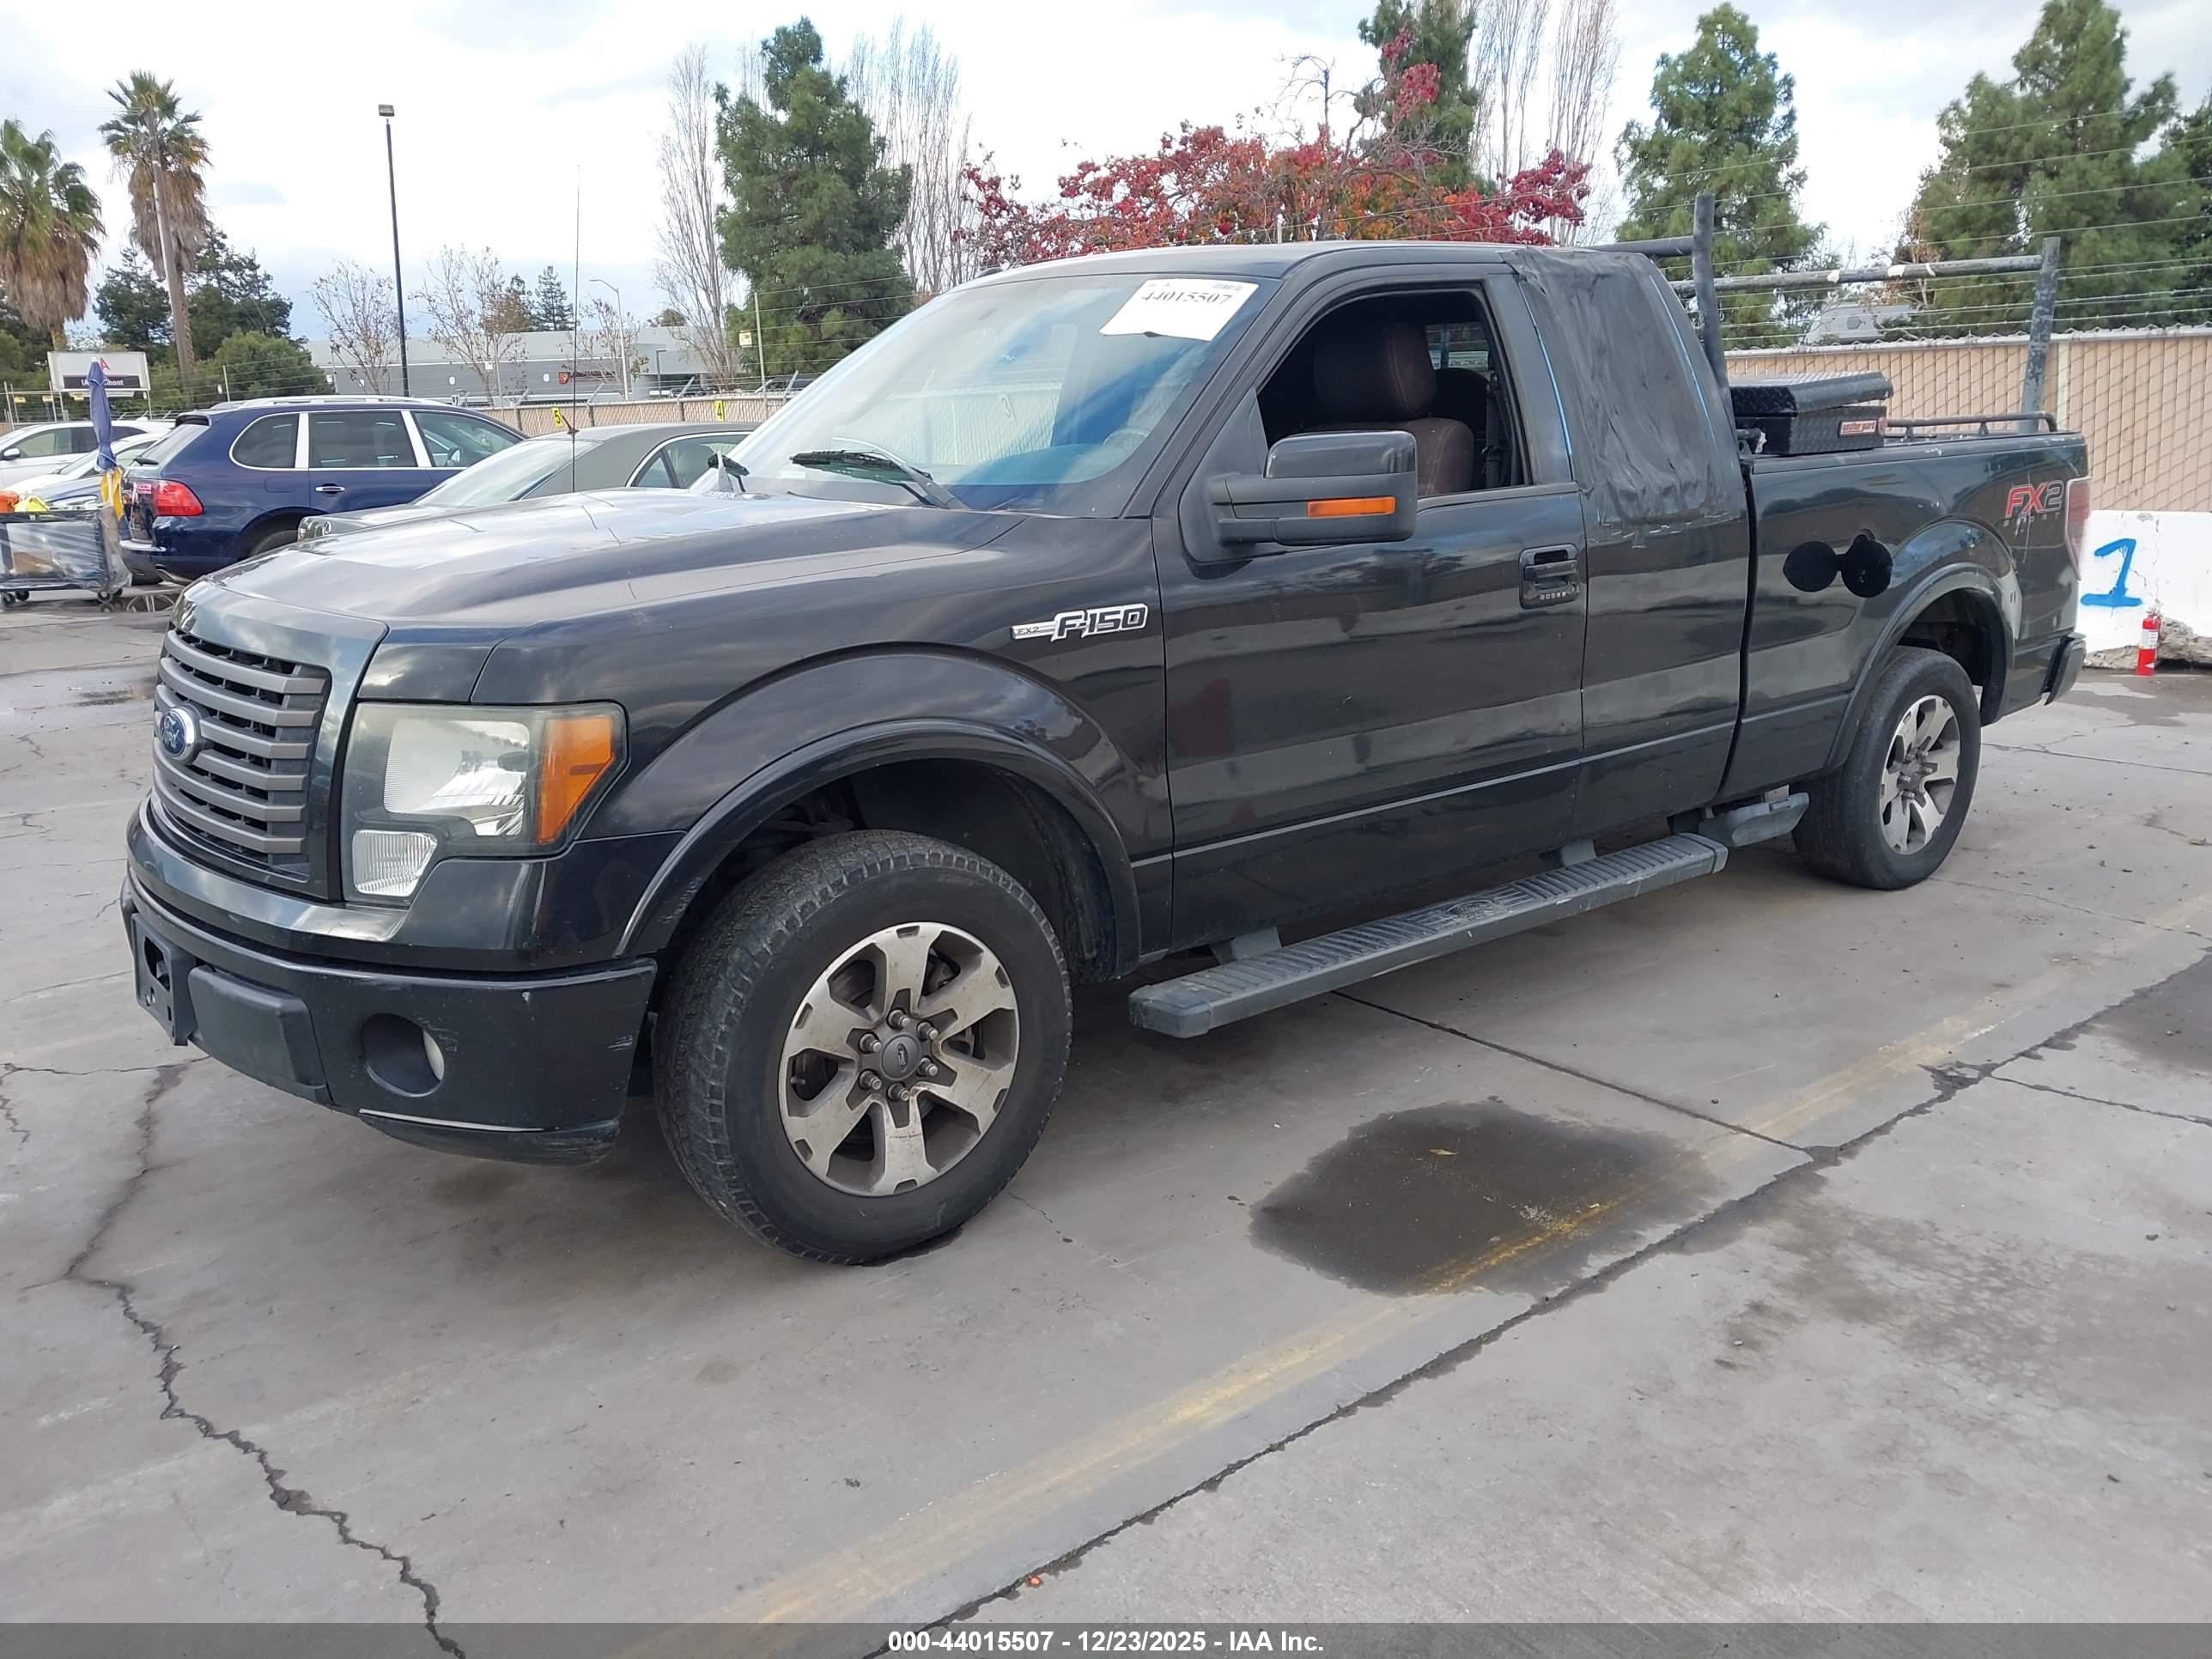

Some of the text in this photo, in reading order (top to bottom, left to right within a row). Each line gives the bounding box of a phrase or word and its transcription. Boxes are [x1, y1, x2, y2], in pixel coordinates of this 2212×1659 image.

[1141, 290, 1234, 305] 44015507
[554, 410, 562, 425] 5
[716, 402, 724, 420] 4
[2005, 479, 2065, 519] FX2
[2081, 538, 2142, 607] 1
[1051, 603, 1148, 642] F-150
